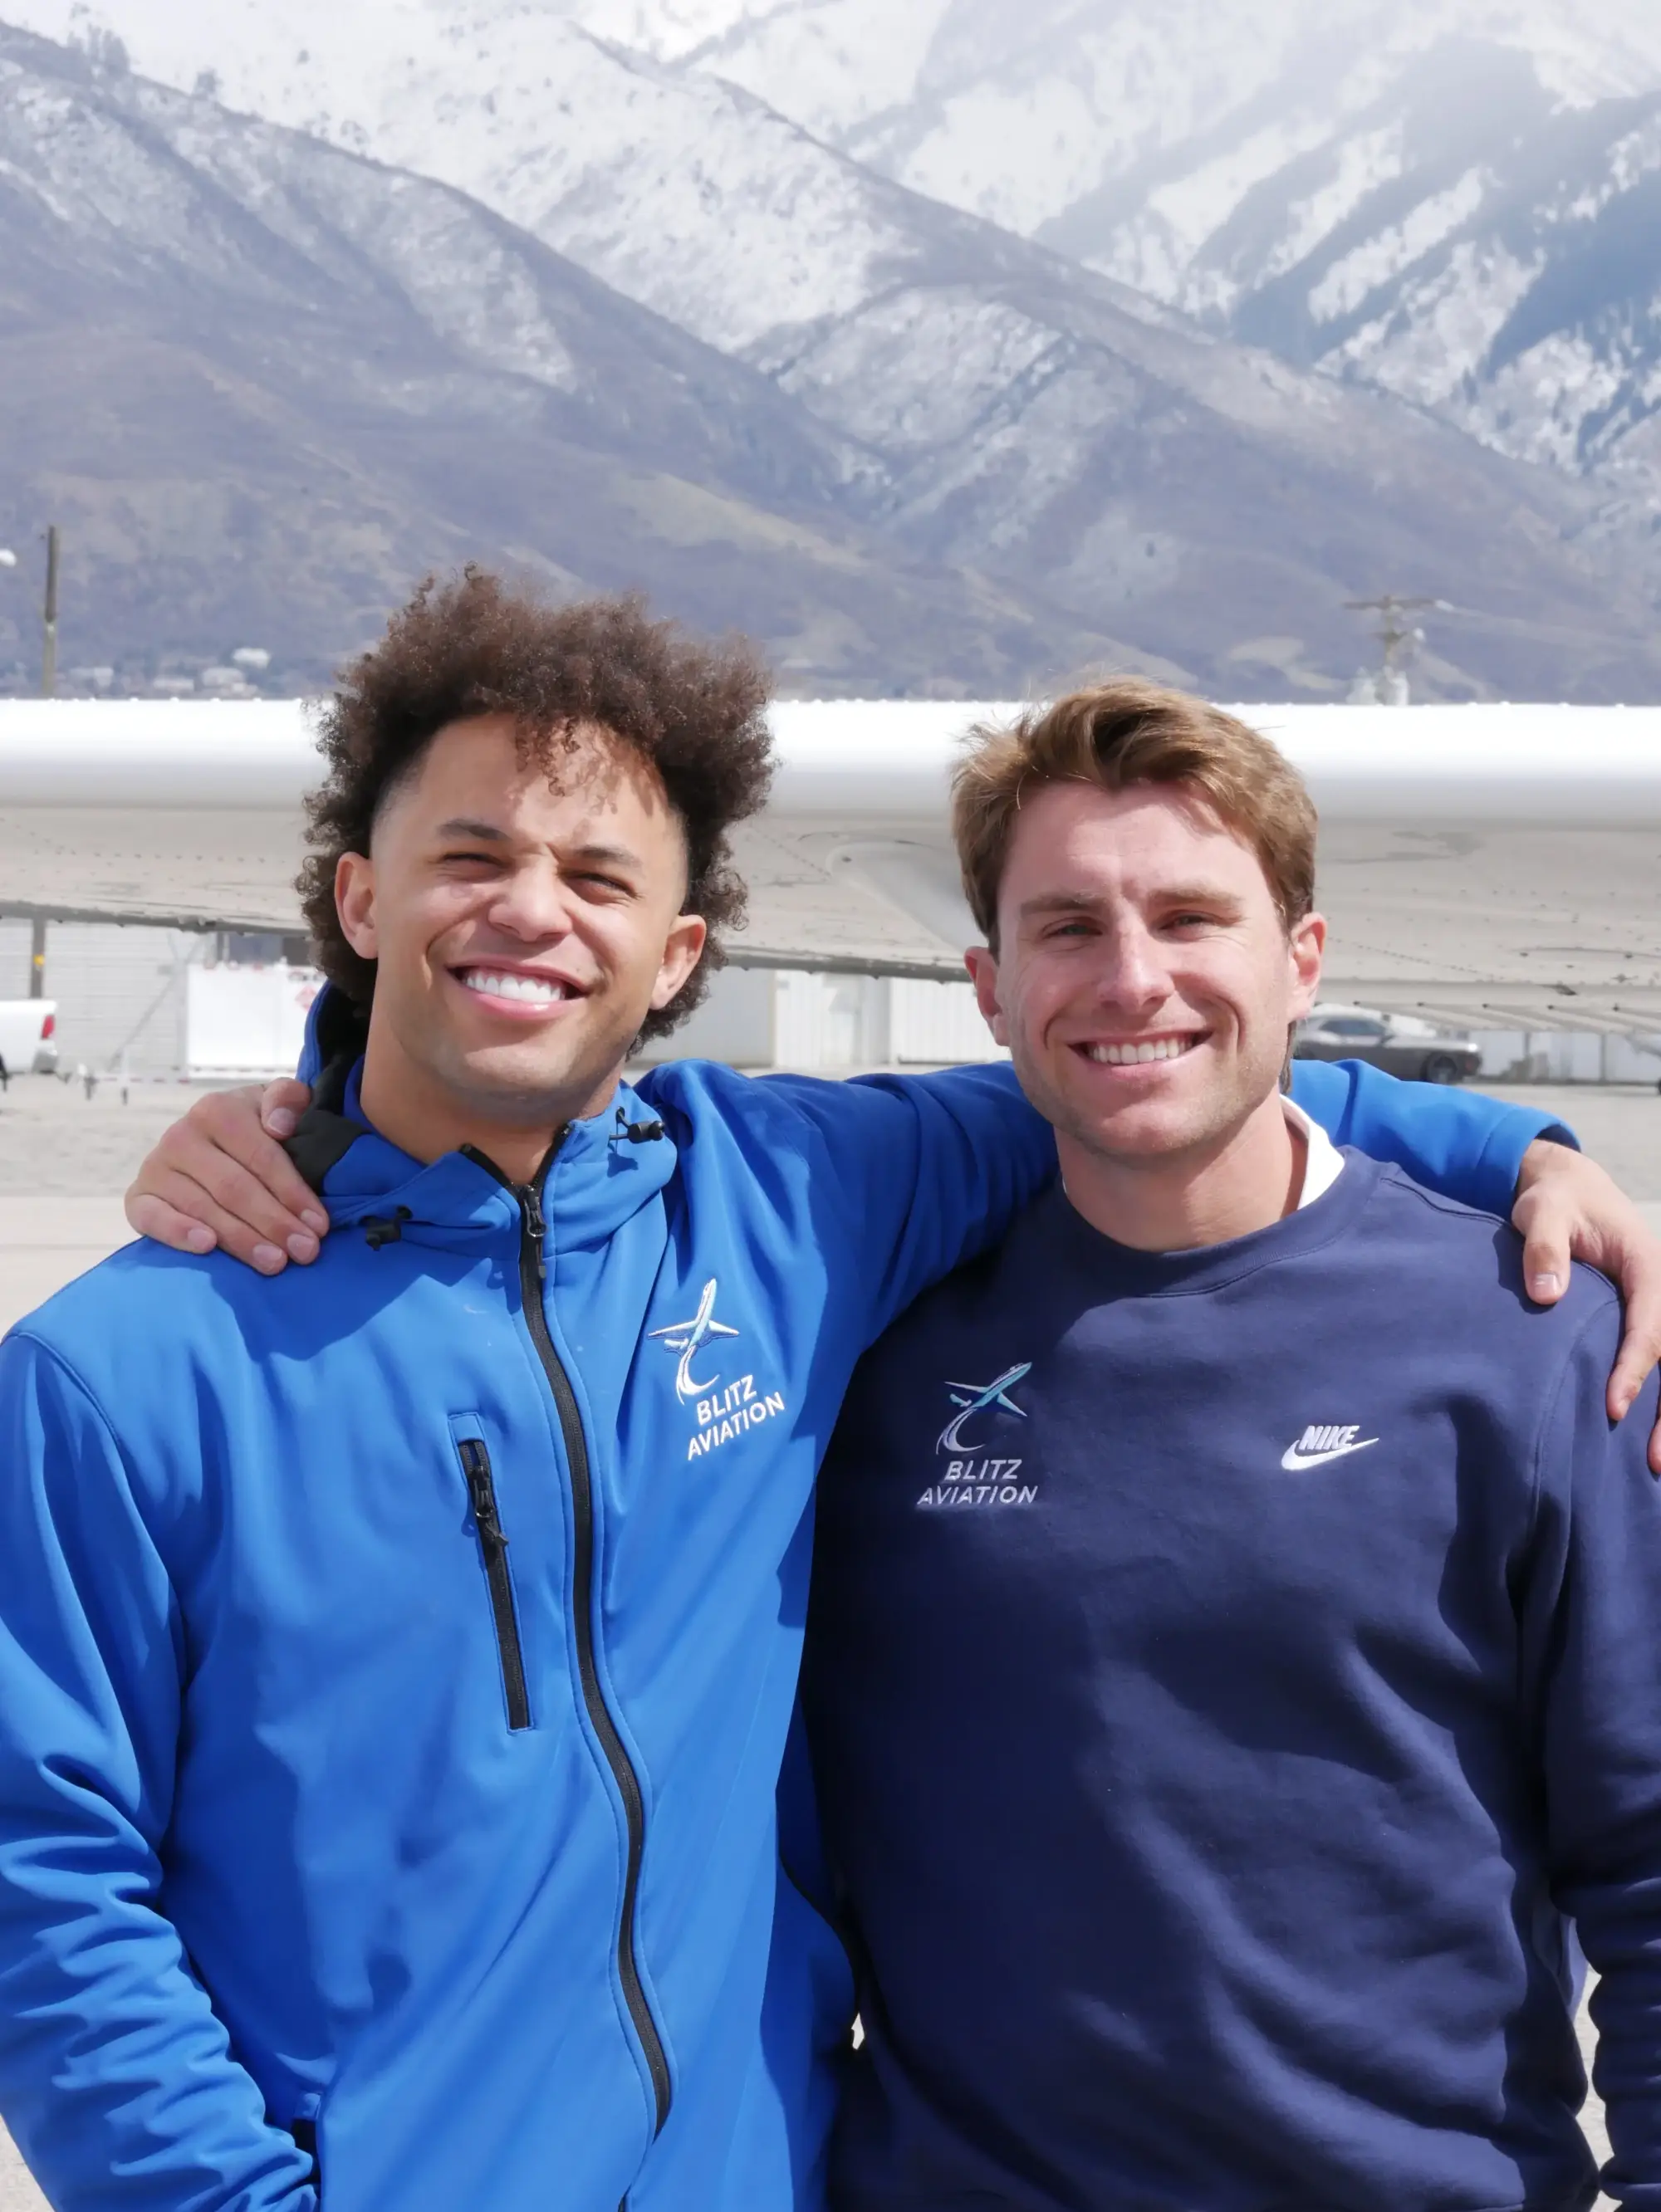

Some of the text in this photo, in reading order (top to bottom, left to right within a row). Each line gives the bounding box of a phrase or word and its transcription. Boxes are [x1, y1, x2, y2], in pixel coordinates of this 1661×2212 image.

[696, 1374, 757, 1426] BLITZ
[688, 1392, 786, 1461] AVIATION
[1297, 1425, 1360, 1450] NIKE
[943, 1459, 1022, 1480] BLITZ
[917, 1485, 1038, 1505] AVIATION
